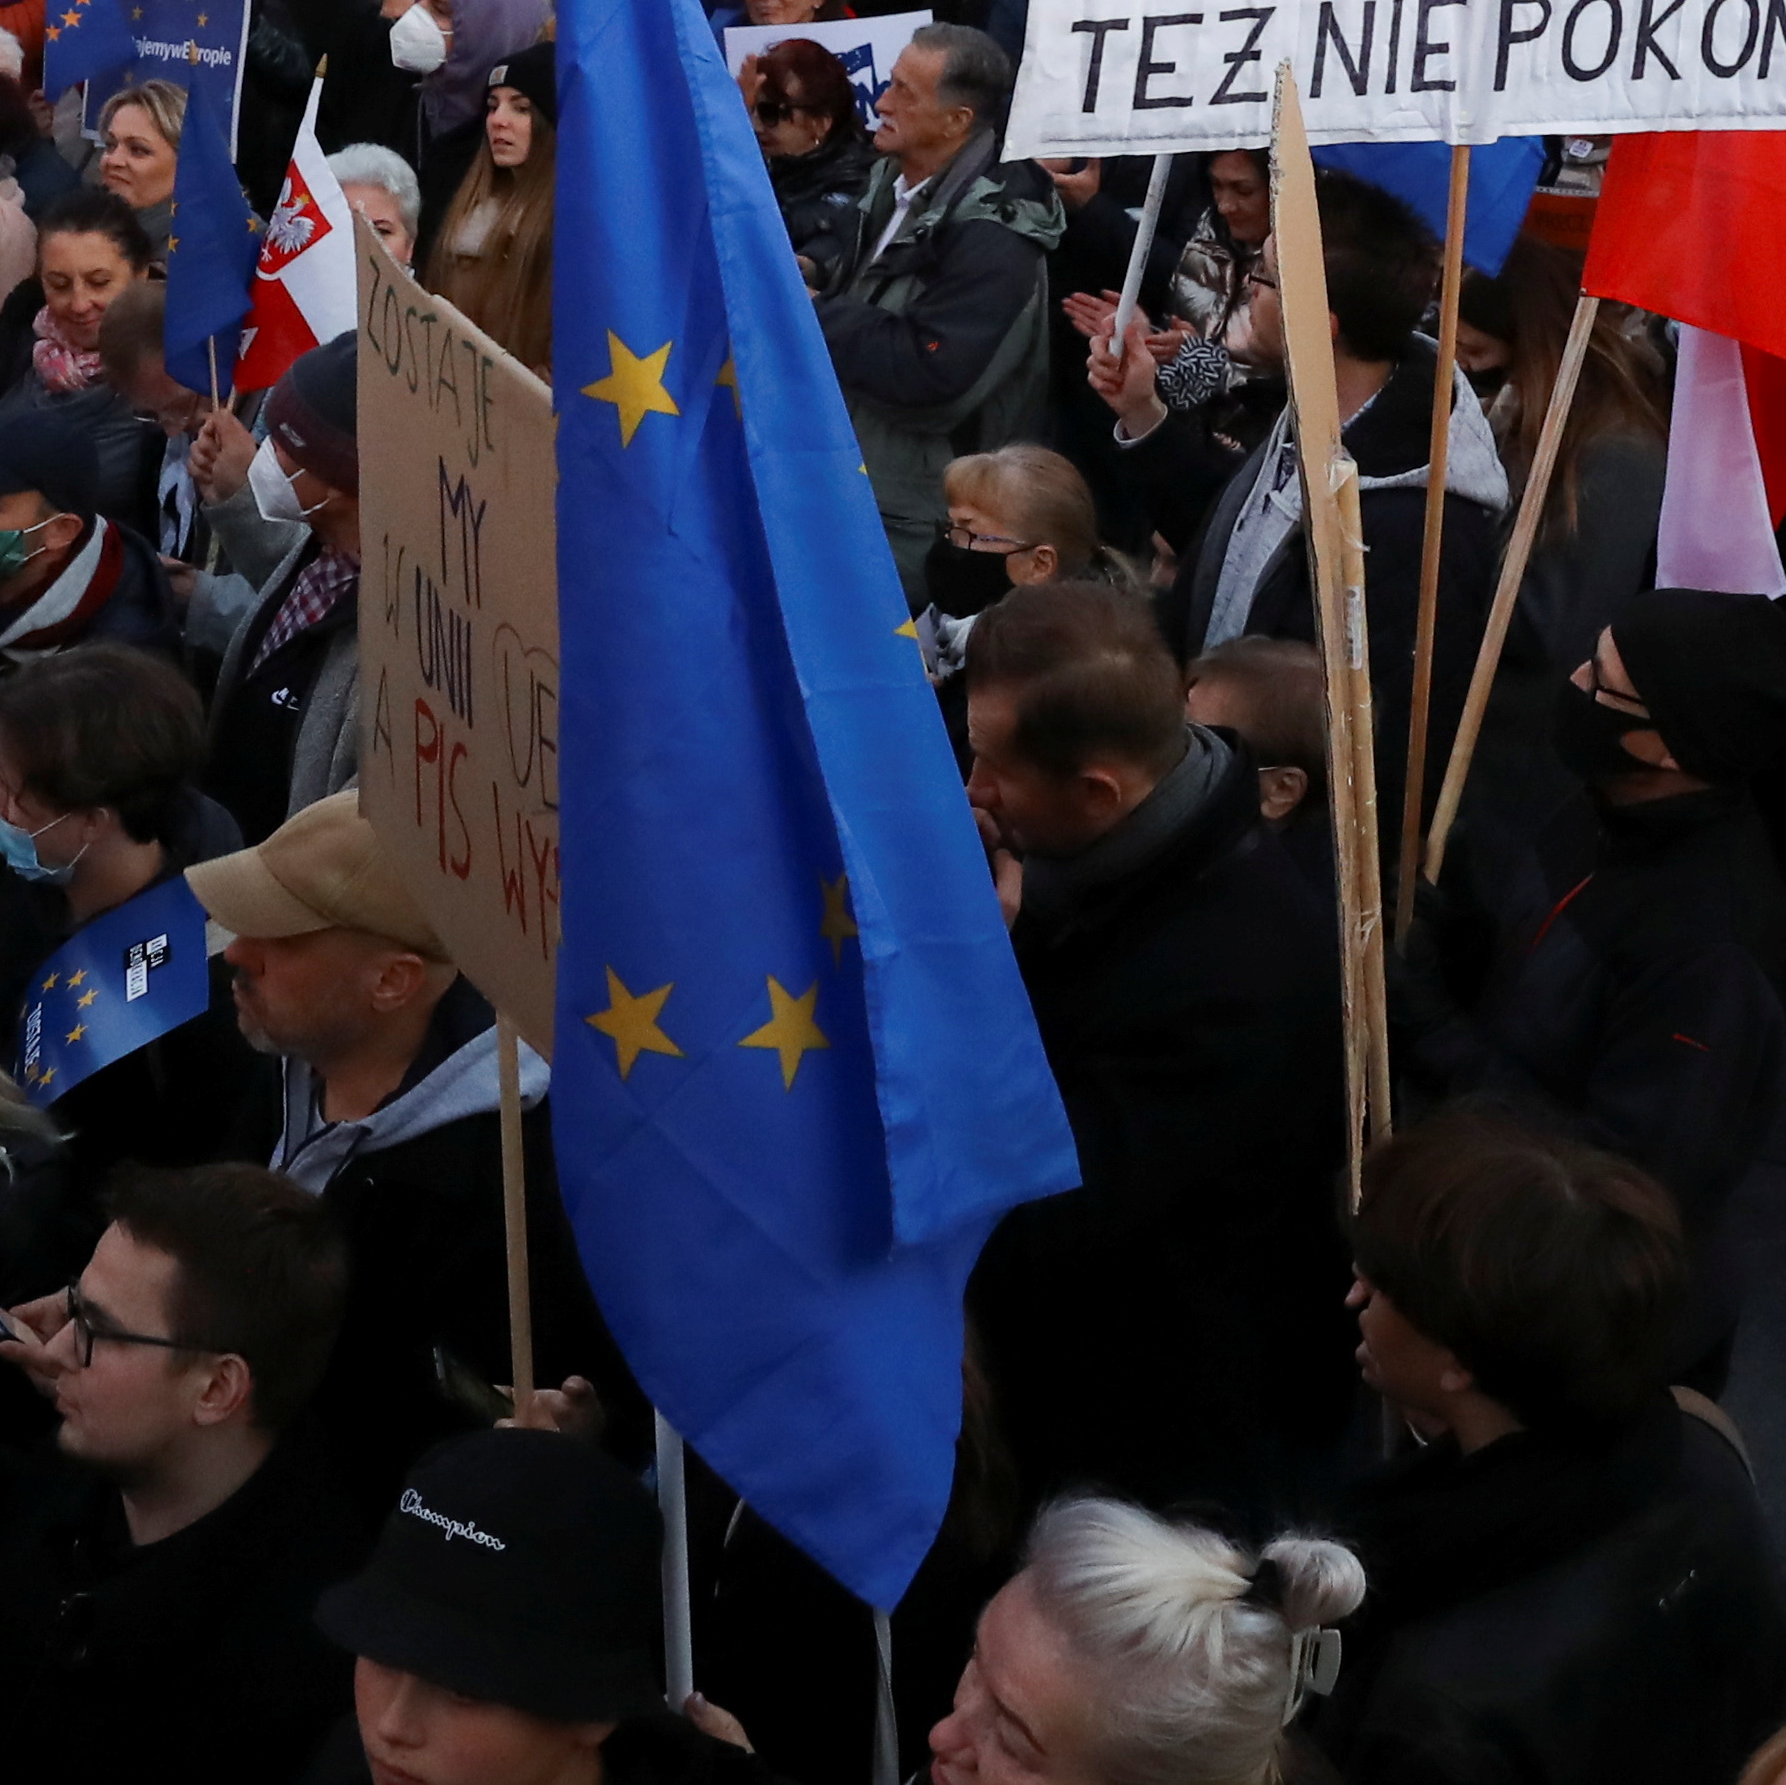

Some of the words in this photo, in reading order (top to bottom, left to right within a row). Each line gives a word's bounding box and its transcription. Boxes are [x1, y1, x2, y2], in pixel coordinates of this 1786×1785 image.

[438, 454, 487, 611] MY
[416, 564, 474, 731] UNII
[415, 697, 471, 881] PIS
[399, 1488, 506, 1551] Champion
